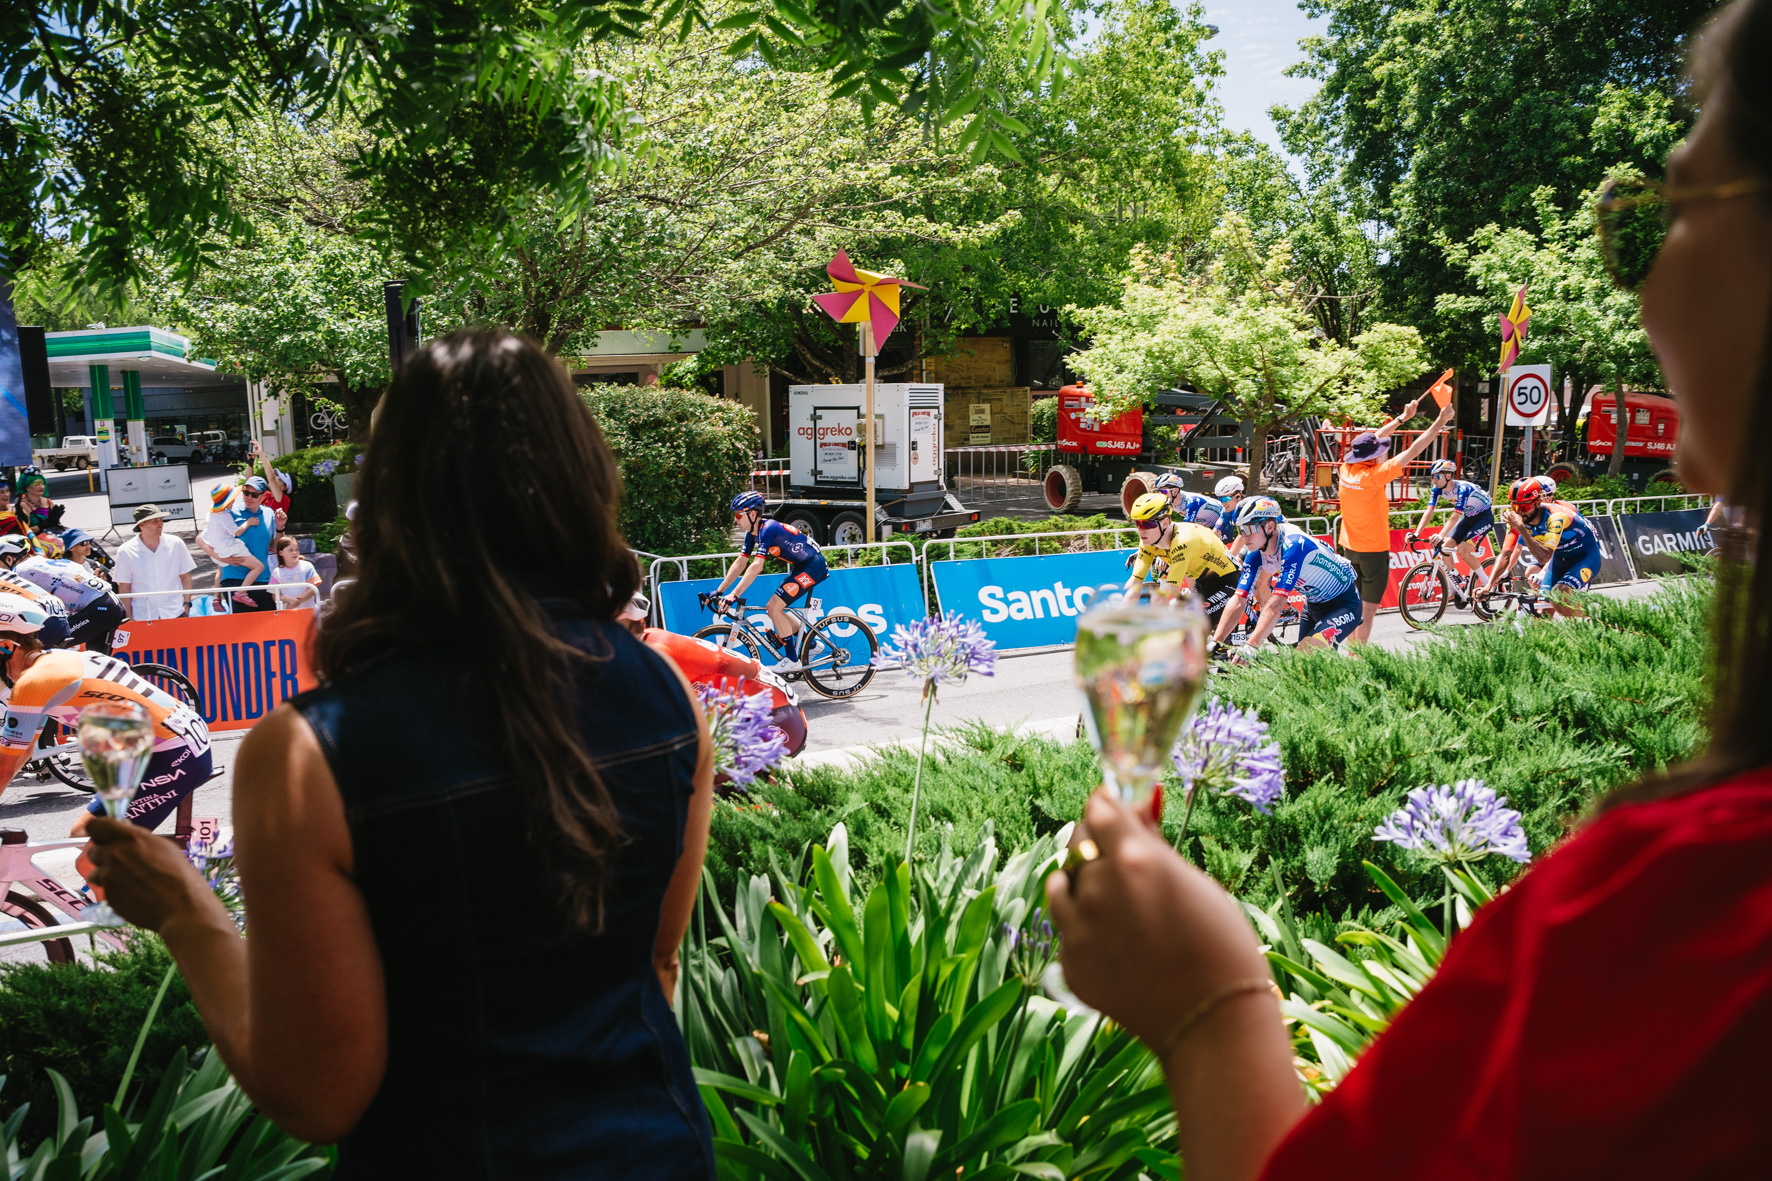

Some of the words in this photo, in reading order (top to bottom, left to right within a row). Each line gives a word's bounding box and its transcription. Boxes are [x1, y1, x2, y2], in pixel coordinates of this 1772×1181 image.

[1517, 385, 1542, 406] 50
[1637, 531, 1715, 556] GARMIN
[1286, 562, 1298, 585] BORA
[1313, 553, 1348, 582] hansgrohe
[1208, 590, 1227, 604] VISMA
[819, 616, 850, 629] ursus
[1333, 612, 1356, 628] BORA
[117, 633, 126, 644] 97
[740, 635, 760, 660] ursu
[1233, 633, 1246, 641] 153
[196, 639, 299, 724] UNDER
[200, 820, 211, 841] 101
